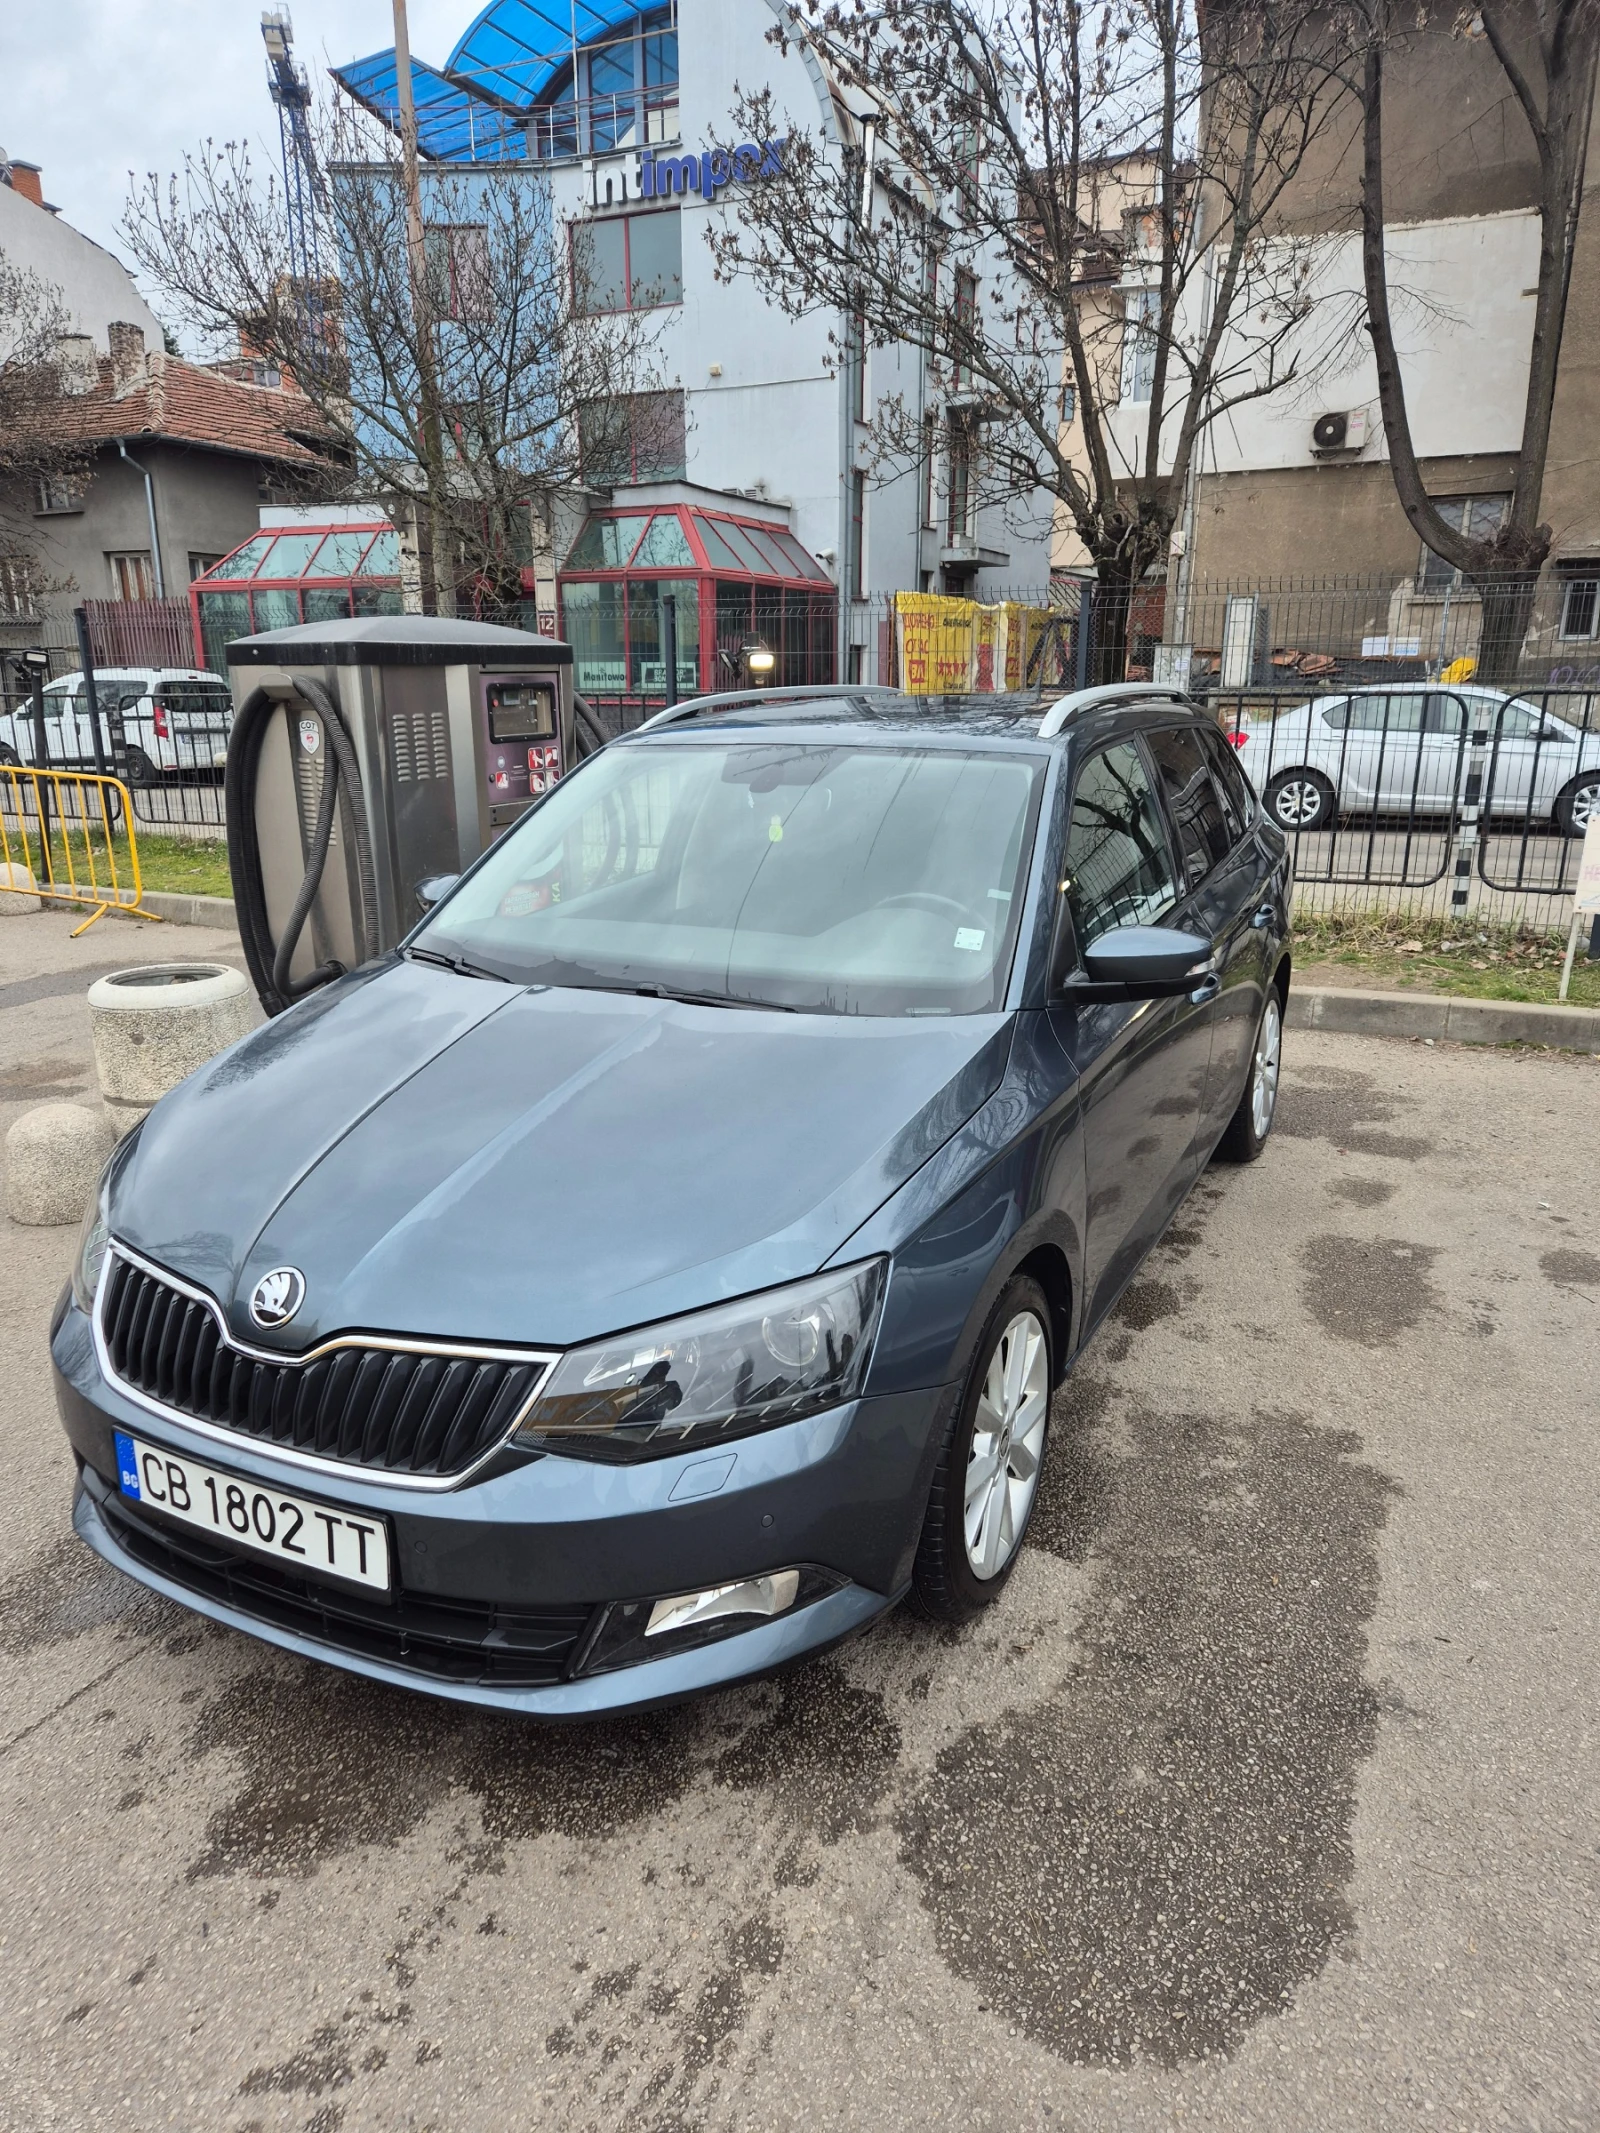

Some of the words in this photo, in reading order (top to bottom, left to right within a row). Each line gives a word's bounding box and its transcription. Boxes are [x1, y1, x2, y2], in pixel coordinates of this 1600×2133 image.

[540, 617, 554, 630] 12
[583, 670, 626, 682] Manitowo
[122, 1470, 139, 1489] BG
[142, 1452, 191, 1511] CB
[204, 1476, 306, 1555] 1802
[314, 1511, 375, 1574] TT
